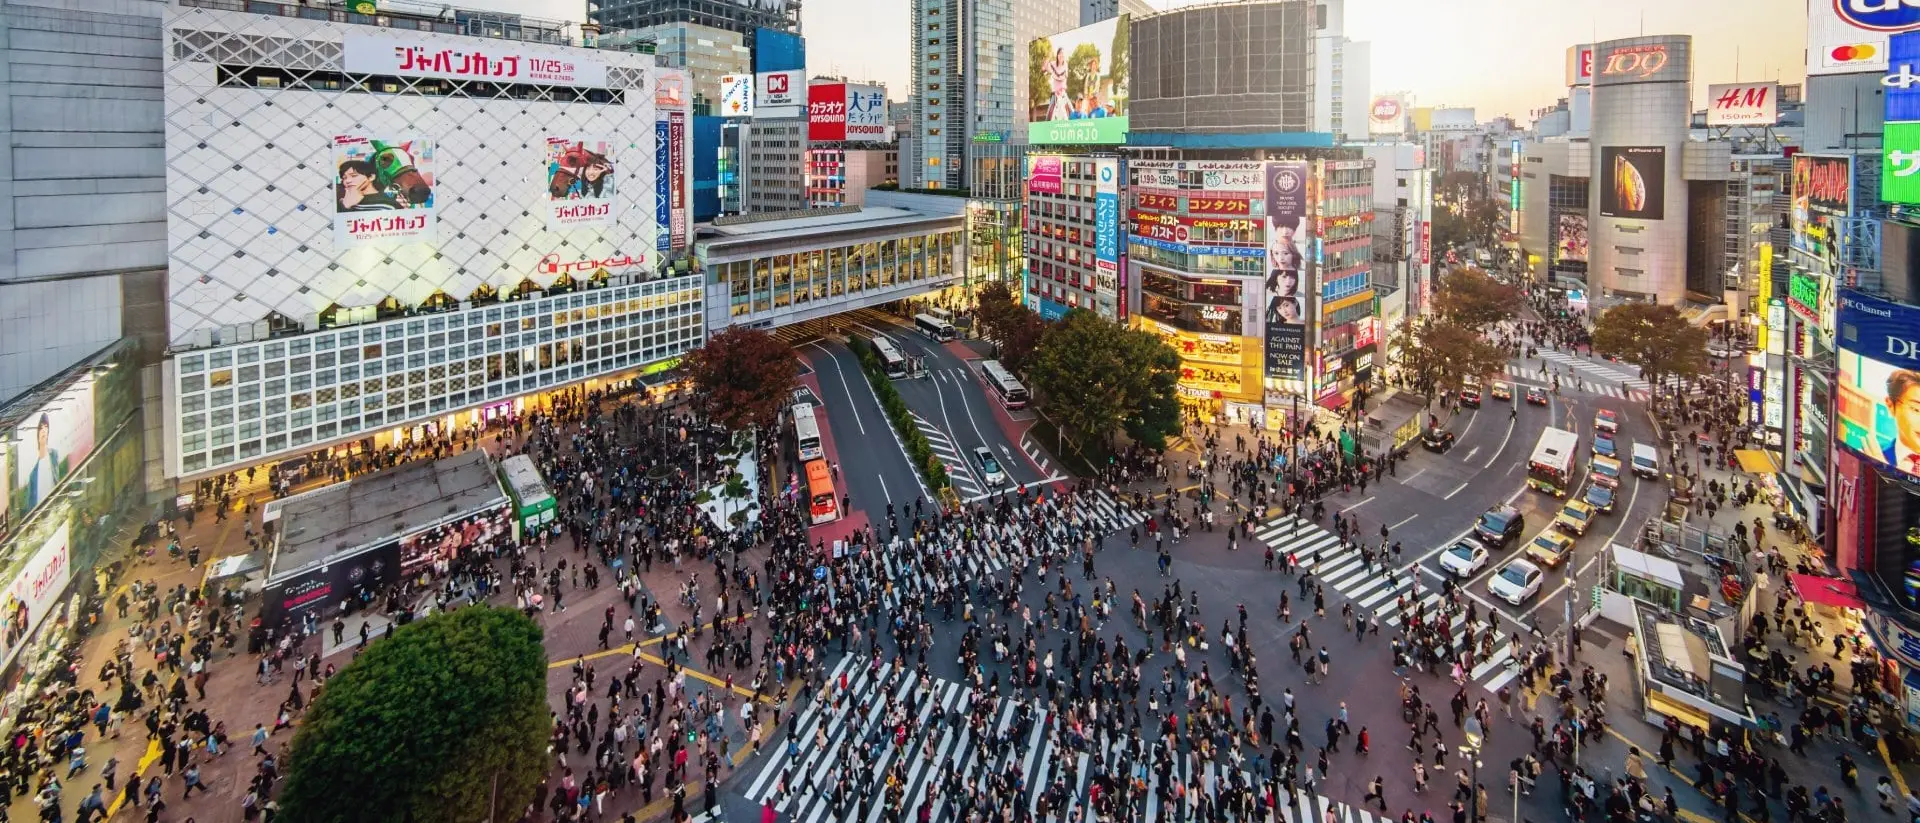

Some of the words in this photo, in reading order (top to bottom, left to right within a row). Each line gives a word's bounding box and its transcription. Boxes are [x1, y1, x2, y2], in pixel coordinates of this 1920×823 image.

[395, 46, 521, 78] ジャパンカップ
[529, 58, 561, 73] 11/25
[1602, 50, 1667, 78] 109
[769, 76, 786, 91] DC
[847, 90, 884, 113] 大声
[1716, 86, 1768, 109] H&M
[810, 101, 844, 115] カラオケ
[810, 114, 845, 123] JOYSOUND
[847, 125, 884, 134] JOYSOUND
[1198, 162, 1261, 170] しゃぶしゃぶバイキング
[555, 203, 610, 218] ジャパンカップ
[1189, 199, 1247, 211] コンタクト
[346, 214, 427, 234] ジャパンカップ
[1098, 198, 1107, 255] アイシティ
[1160, 214, 1180, 227] ガスト
[1229, 219, 1258, 232] ガスト
[1150, 224, 1175, 240] ガスト
[559, 254, 645, 273] TOKYU
[1097, 274, 1116, 291] No.1
[1856, 301, 1891, 318] Channel
[1270, 342, 1284, 350] THE
[1285, 343, 1302, 351] PAIN
[1271, 336, 1301, 344] AGAINST
[1269, 352, 1288, 360] NOW
[1289, 353, 1301, 361] ON
[1356, 352, 1372, 369] LUSH
[33, 543, 66, 600] ジャパンカップ
